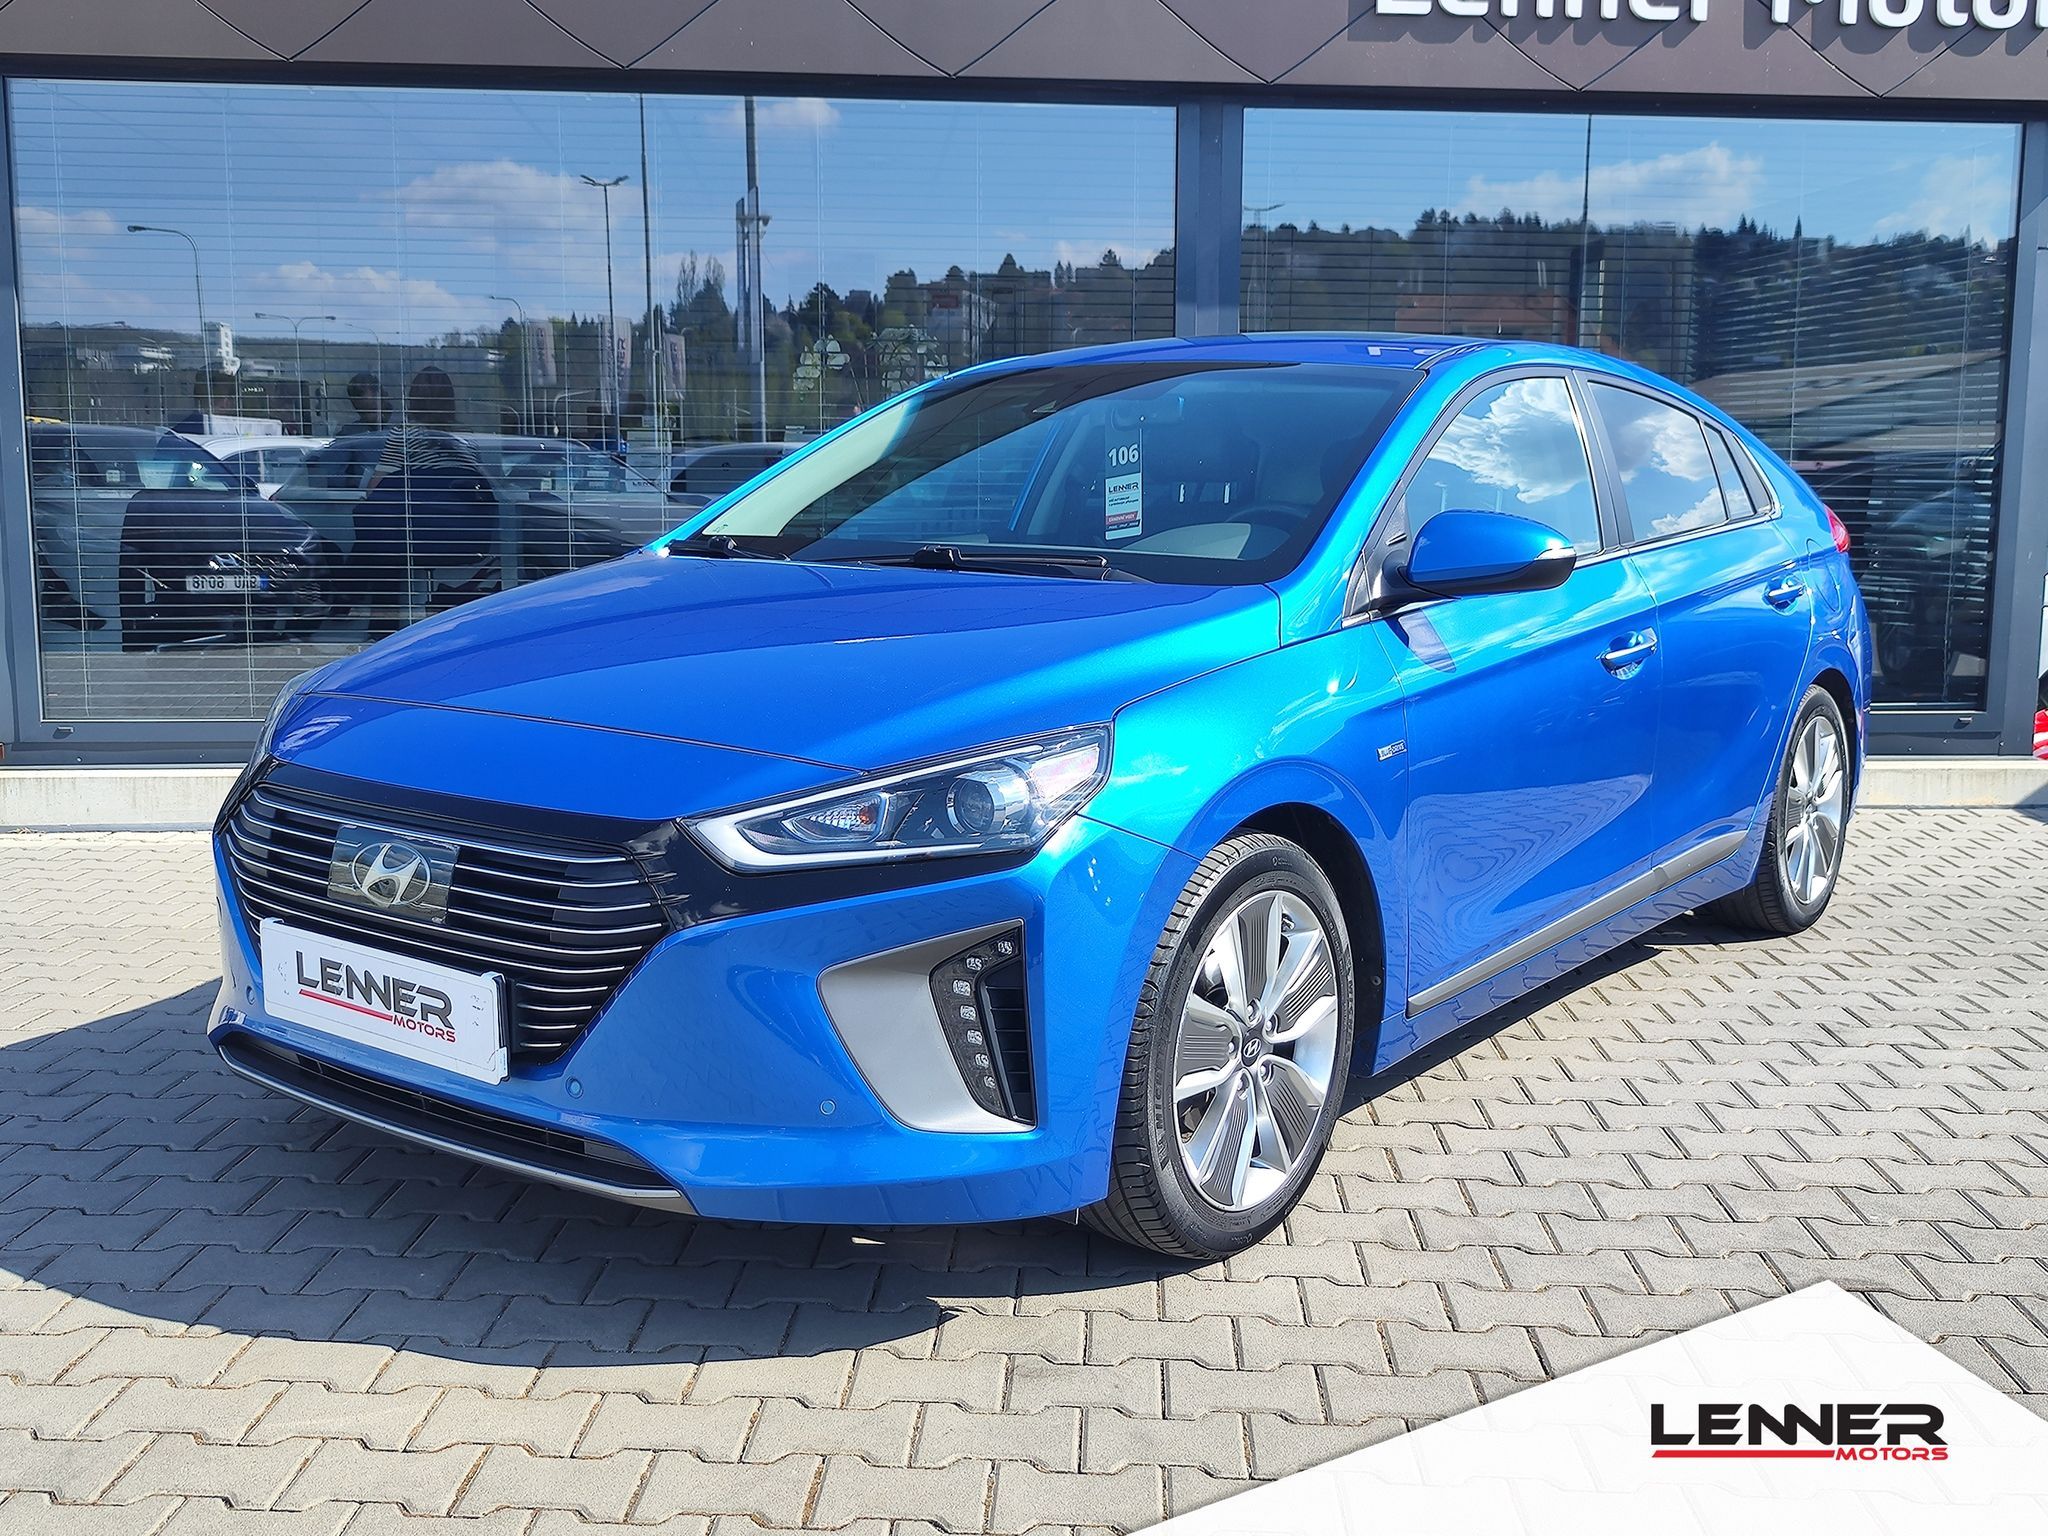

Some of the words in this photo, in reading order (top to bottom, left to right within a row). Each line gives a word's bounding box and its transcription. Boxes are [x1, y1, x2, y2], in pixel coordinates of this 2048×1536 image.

[1108, 444, 1139, 467] 106
[296, 950, 455, 1029] LENNER
[392, 1014, 456, 1042] MOTORS
